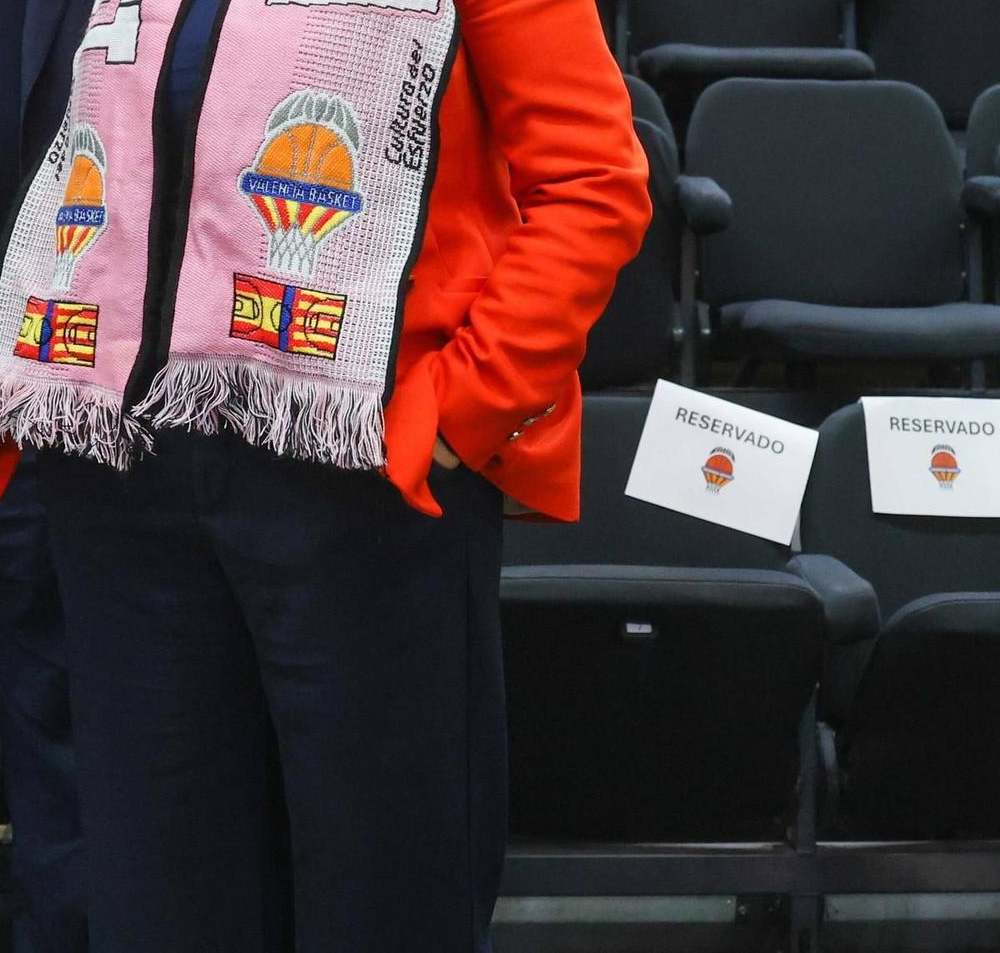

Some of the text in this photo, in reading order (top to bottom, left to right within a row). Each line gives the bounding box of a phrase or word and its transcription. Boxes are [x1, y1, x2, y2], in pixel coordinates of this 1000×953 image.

[385, 39, 423, 165] Cultura del
[403, 63, 435, 172] Esfuerzo
[248, 176, 357, 210] VALENCIA BASKET
[675, 407, 785, 455] RESERVADO
[889, 416, 996, 436] RESERVADO
